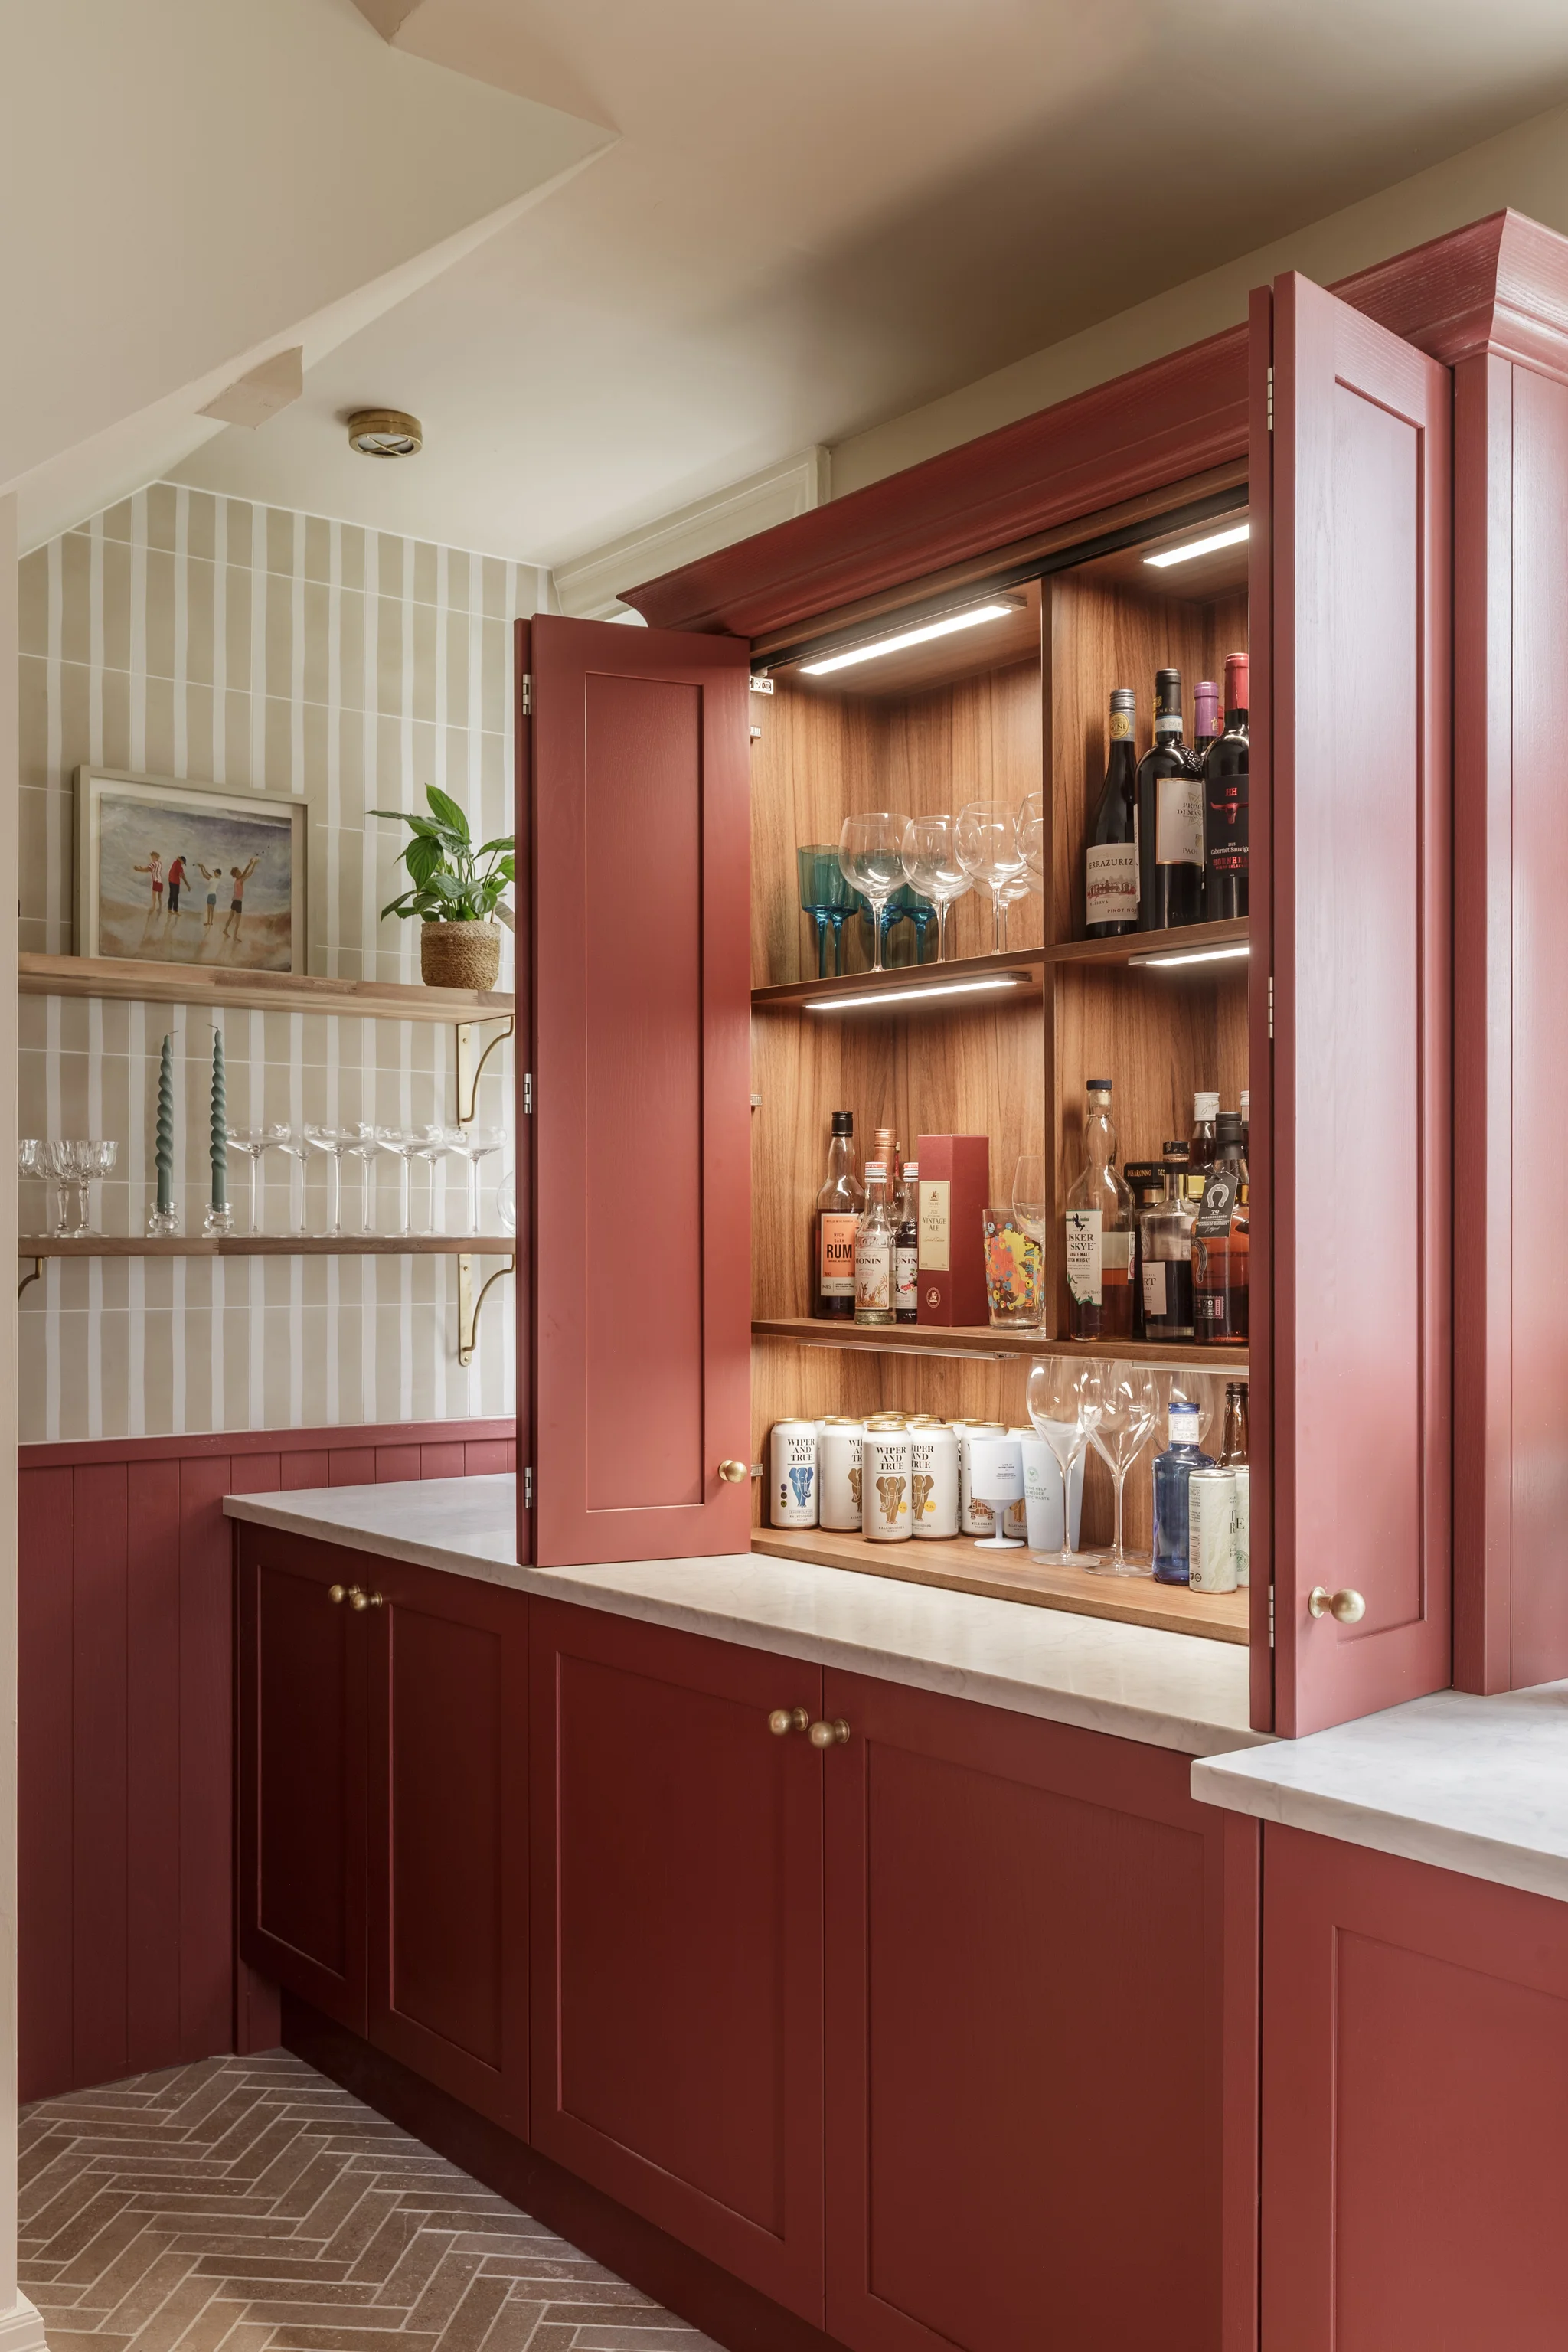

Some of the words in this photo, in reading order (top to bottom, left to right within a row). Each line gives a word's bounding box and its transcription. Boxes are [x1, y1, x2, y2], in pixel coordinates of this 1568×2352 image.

[1226, 788, 1237, 796] HH
[1210, 847, 1230, 855] Cabernet
[1089, 858, 1134, 870] ERRAZURIZ
[827, 1244, 853, 1259] RUM
